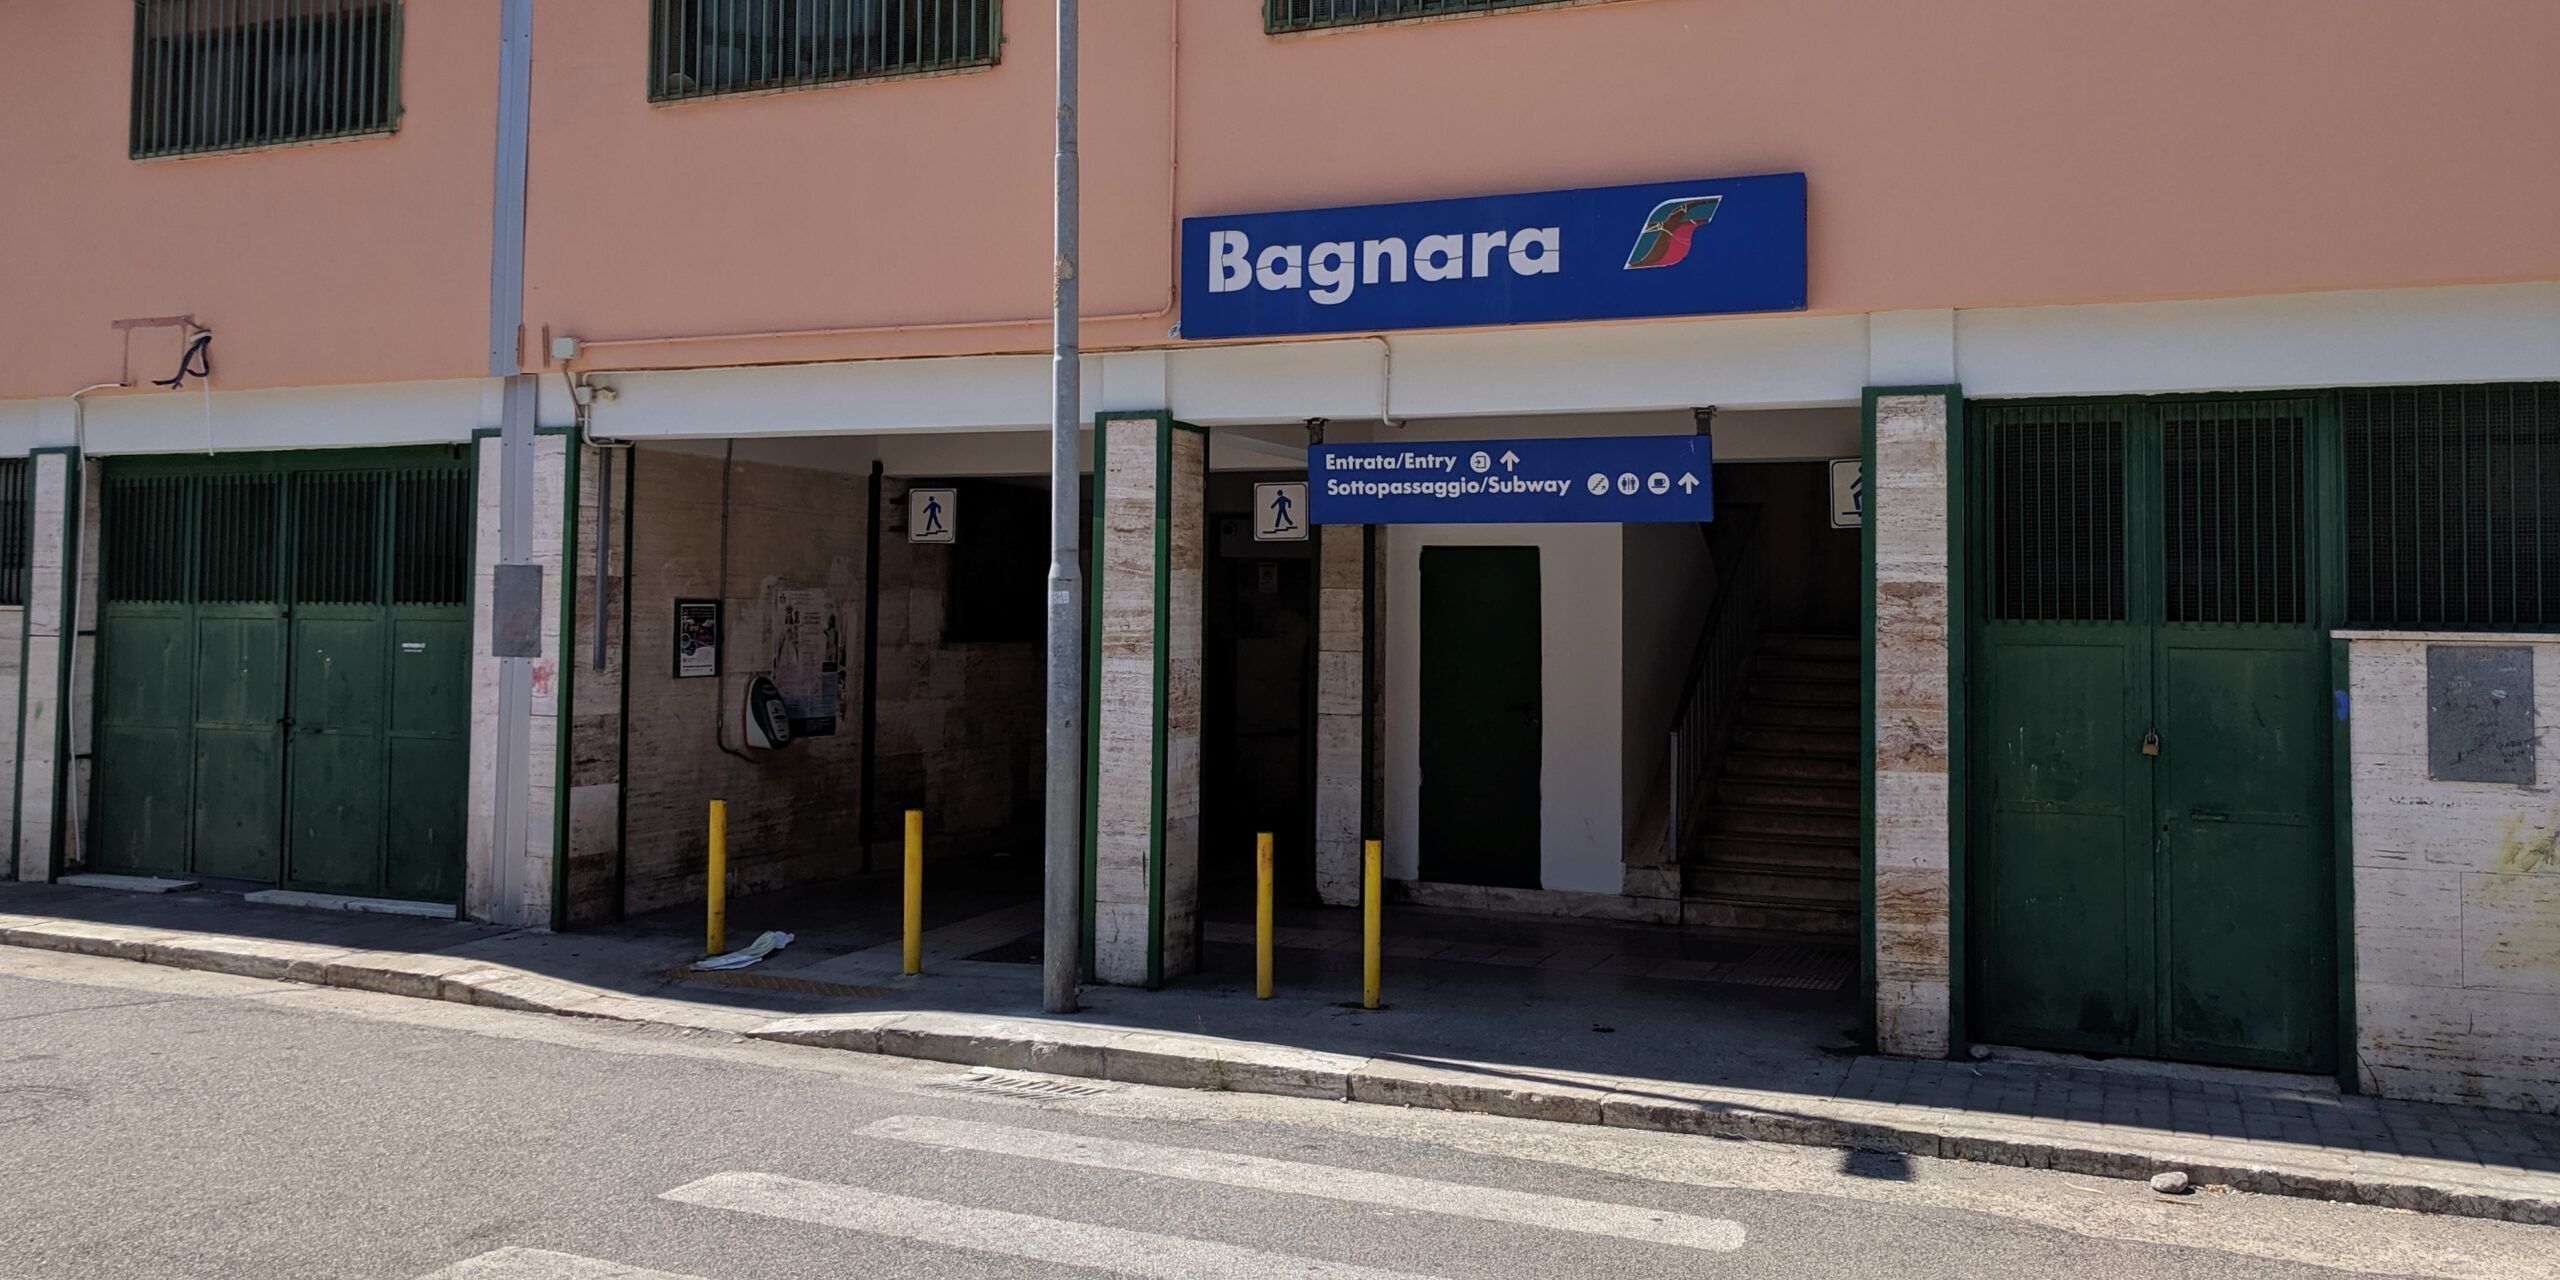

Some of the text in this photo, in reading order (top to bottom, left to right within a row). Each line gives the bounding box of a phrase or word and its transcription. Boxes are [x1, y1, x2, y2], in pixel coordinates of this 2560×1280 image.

[1208, 227, 1560, 304] Bagnara
[1325, 452, 1457, 473] Entrata/Entry
[1327, 475, 1571, 498] Sottopassaggio/Subway
